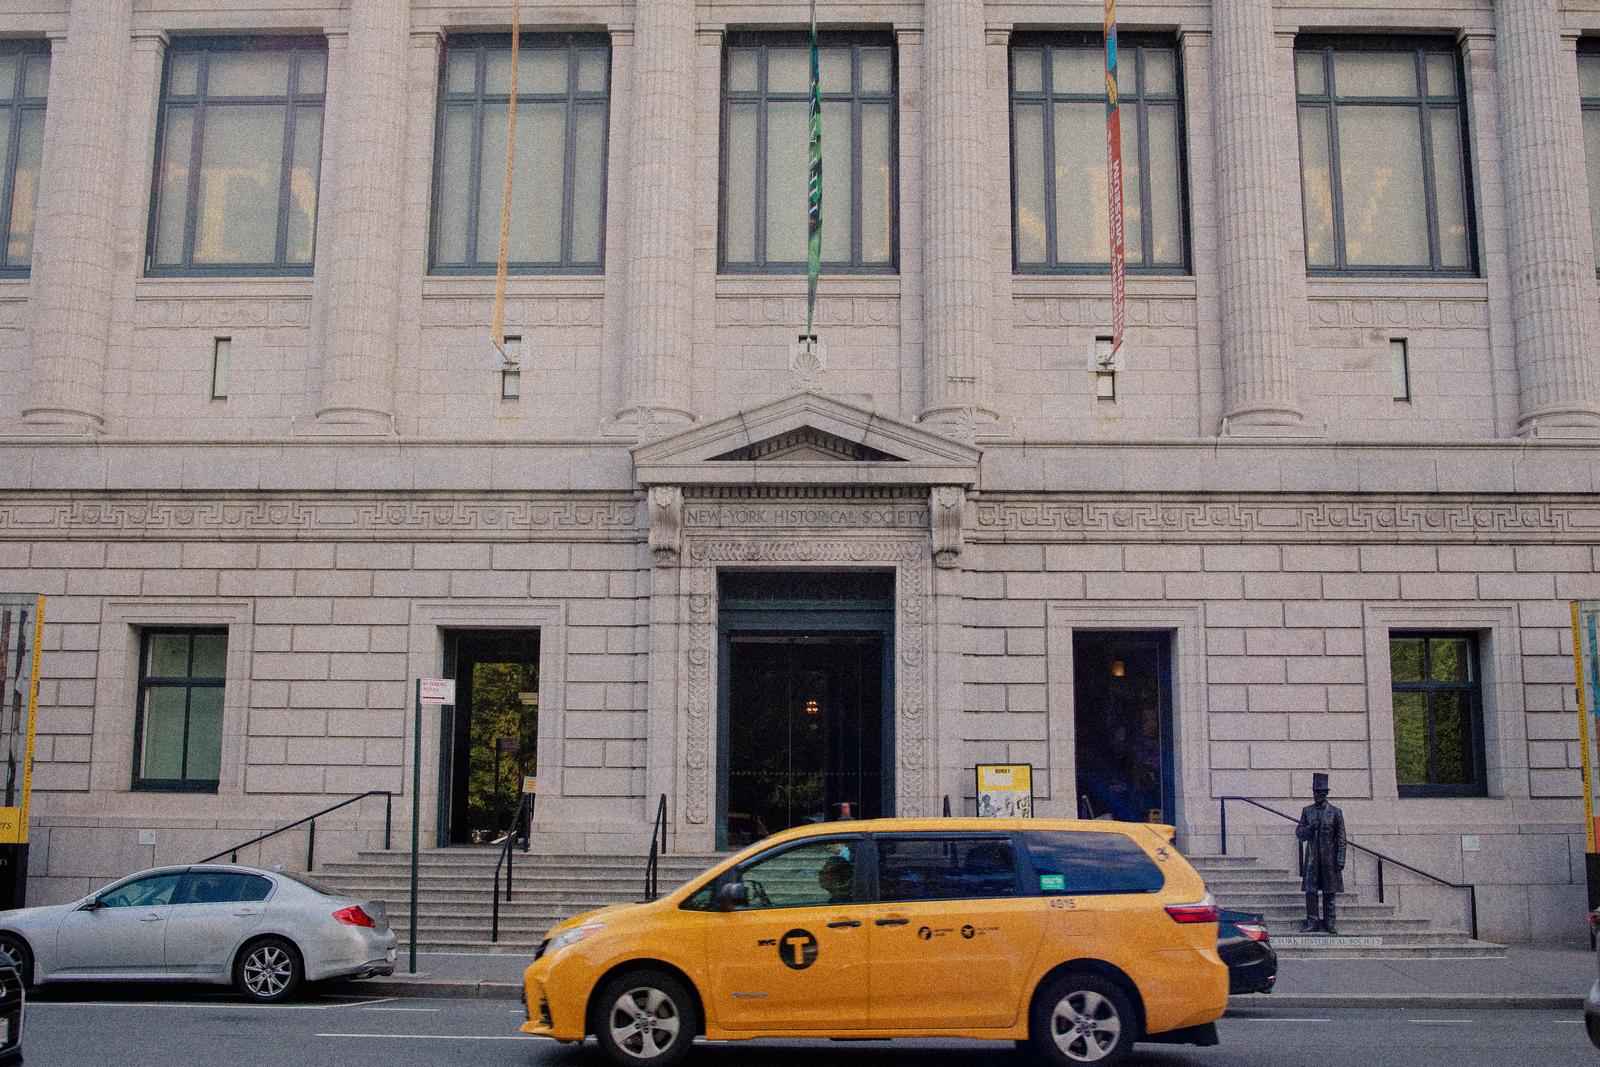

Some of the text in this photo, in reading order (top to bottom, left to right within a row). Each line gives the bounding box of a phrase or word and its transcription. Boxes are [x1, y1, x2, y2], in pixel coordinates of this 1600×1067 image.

[1113, 160, 1123, 245] MUSEUM
[774, 510, 857, 523] HISTORICAL
[862, 510, 925, 524] SOCIETY
